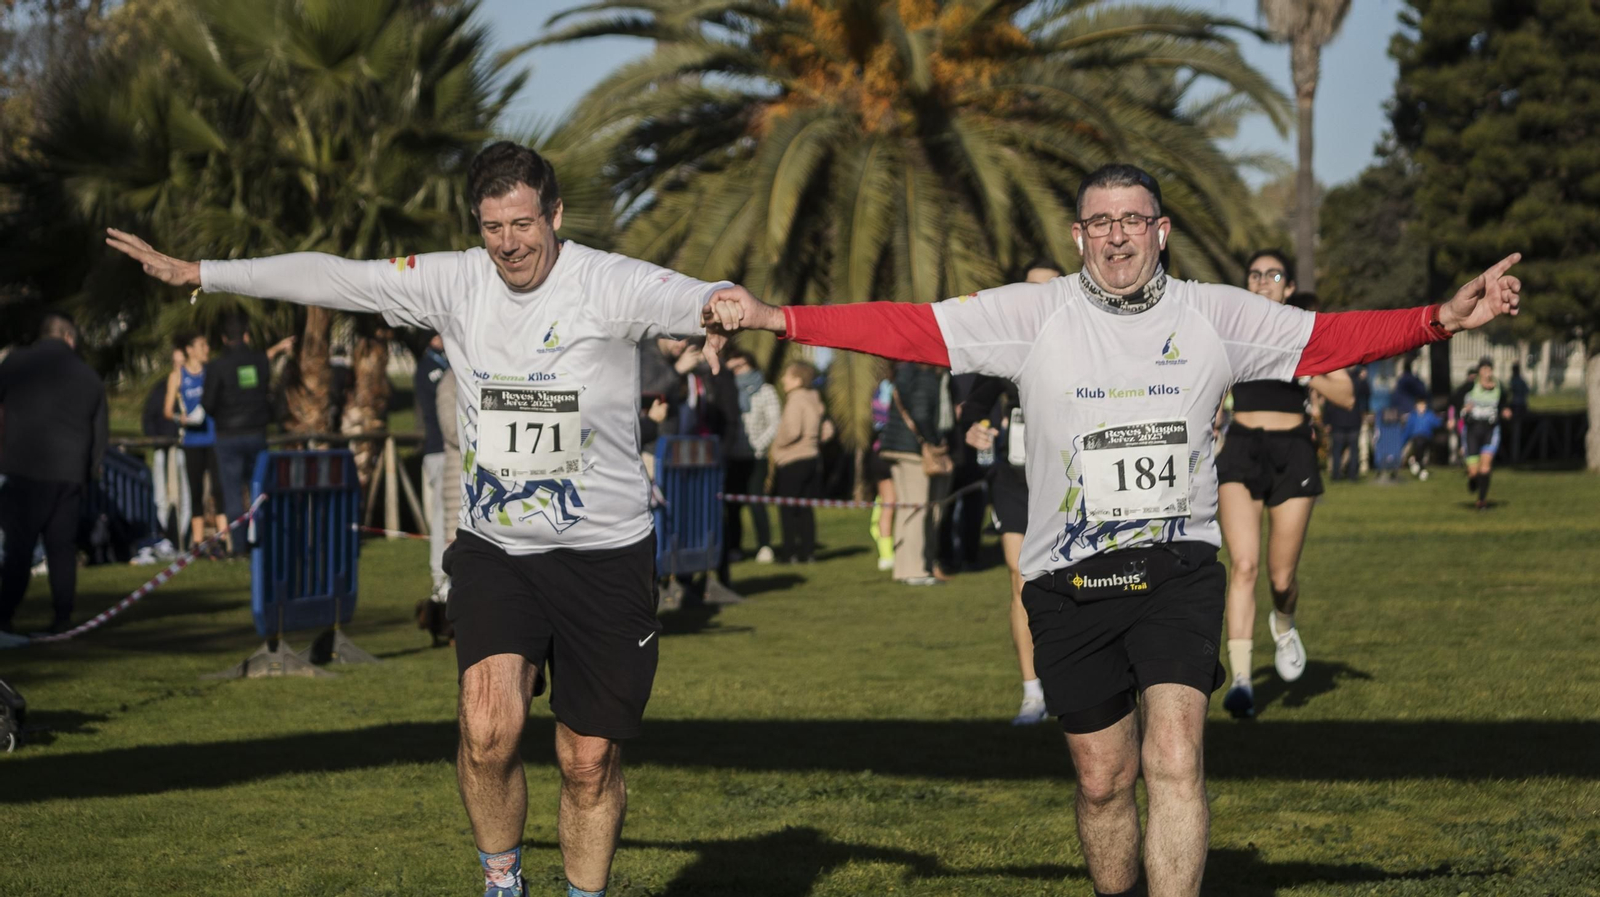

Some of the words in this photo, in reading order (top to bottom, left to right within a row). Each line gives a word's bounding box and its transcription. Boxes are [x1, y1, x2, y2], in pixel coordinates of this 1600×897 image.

[492, 373, 525, 381] Kema
[528, 372, 556, 381] Kilos
[502, 391, 534, 400] Reyes
[538, 392, 576, 404] Magos
[1076, 387, 1106, 399] Klub
[1108, 388, 1145, 399] Kema
[1148, 384, 1180, 396] Kilos
[504, 421, 565, 454] 171
[1105, 428, 1141, 439] Reyes
[1145, 424, 1184, 435] Magos
[1112, 454, 1176, 492] 184
[1130, 582, 1147, 590] Trail
